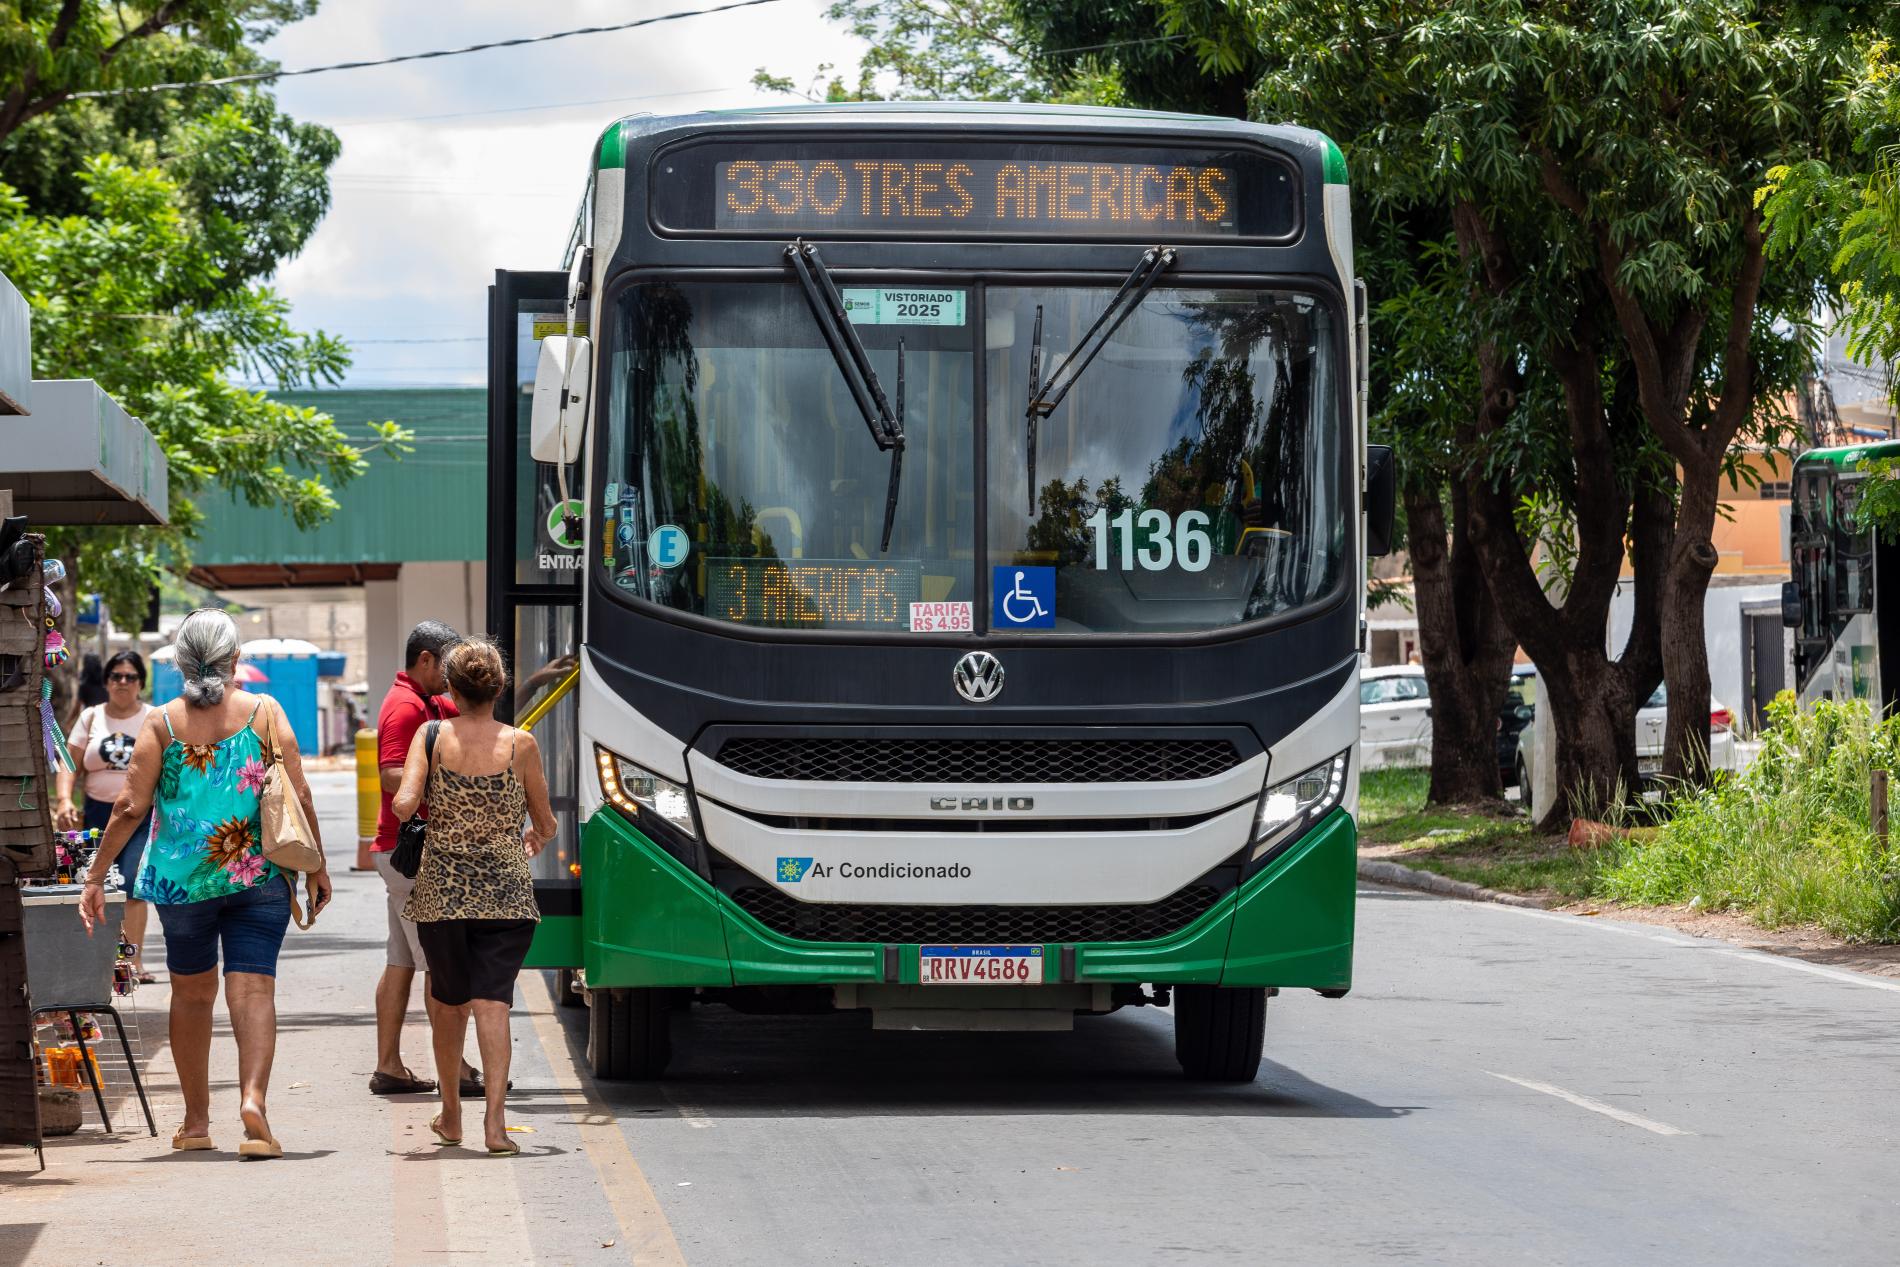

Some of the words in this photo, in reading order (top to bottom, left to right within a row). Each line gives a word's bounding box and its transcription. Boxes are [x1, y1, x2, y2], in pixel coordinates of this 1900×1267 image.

[727, 160, 848, 215] 330
[854, 162, 974, 217] TRES
[995, 164, 1227, 221] AMERICAS
[885, 292, 953, 303] VISTORIADO
[897, 303, 940, 317] 2025
[660, 530, 677, 563] E
[1086, 508, 1212, 572] 1136
[729, 566, 746, 619] 3
[913, 602, 970, 617] TARIFA
[913, 617, 933, 631] R$
[937, 616, 970, 630] 4,95
[930, 797, 1034, 811] CAIO
[811, 862, 834, 878] Ar
[839, 862, 972, 878] Condicionado
[930, 958, 1029, 980] RRV4G86
